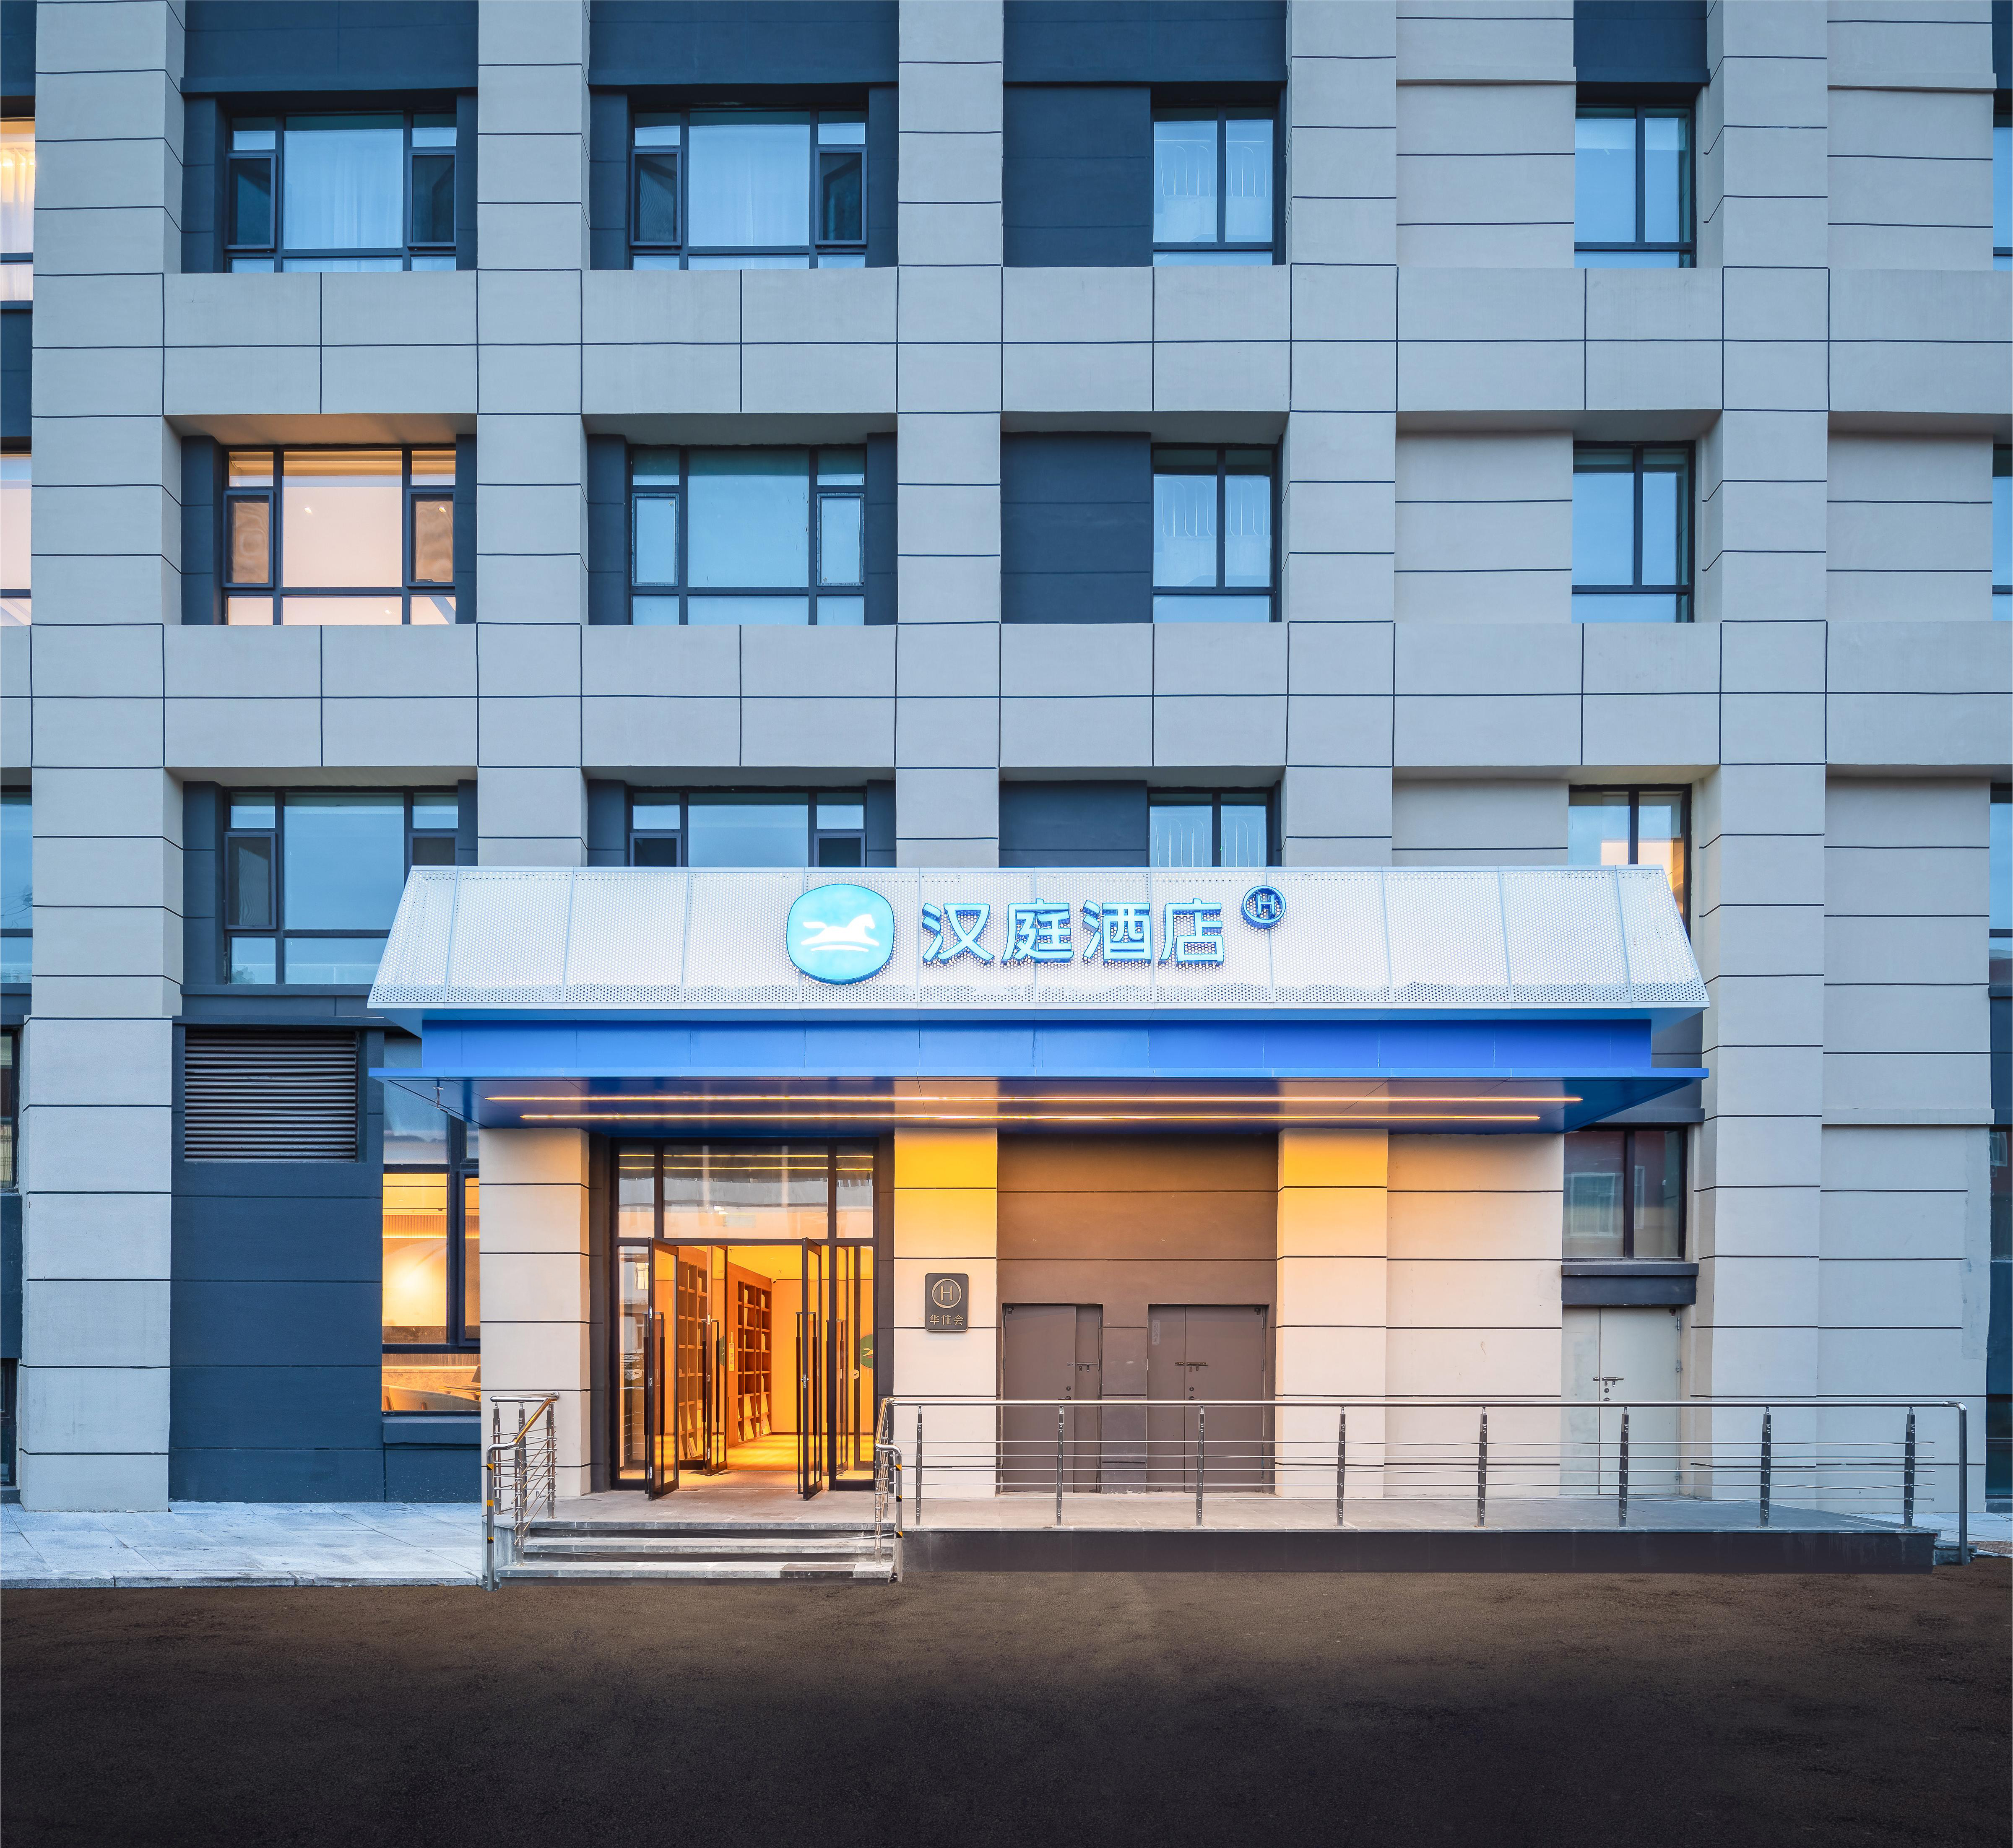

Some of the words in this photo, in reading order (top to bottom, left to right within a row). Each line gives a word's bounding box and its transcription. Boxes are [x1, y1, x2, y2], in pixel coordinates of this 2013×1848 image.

[1256, 894, 1275, 915] H
[922, 898, 1225, 965] 汉庭酒店
[940, 1286, 953, 1301] H
[929, 1314, 964, 1326] 华住会
